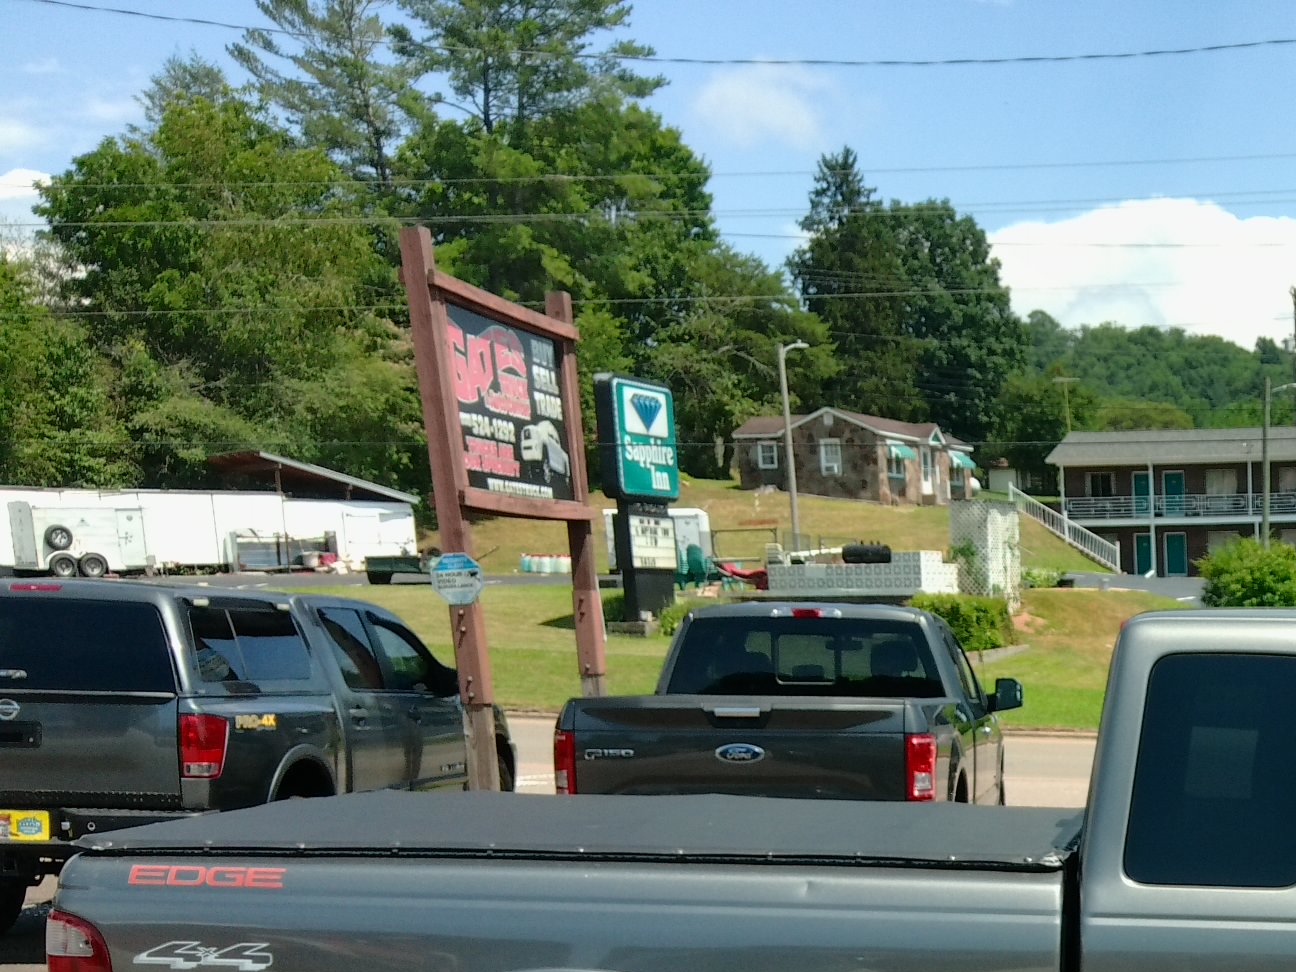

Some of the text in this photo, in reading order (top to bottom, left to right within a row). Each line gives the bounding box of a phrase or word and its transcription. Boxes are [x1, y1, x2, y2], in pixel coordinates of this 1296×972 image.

[532, 364, 560, 395] SELL
[533, 391, 563, 420] TRADE
[624, 434, 675, 468] Sapphire
[650, 465, 671, 491] Inn
[235, 713, 277, 729] PRO-4X
[128, 864, 288, 889] EDGE
